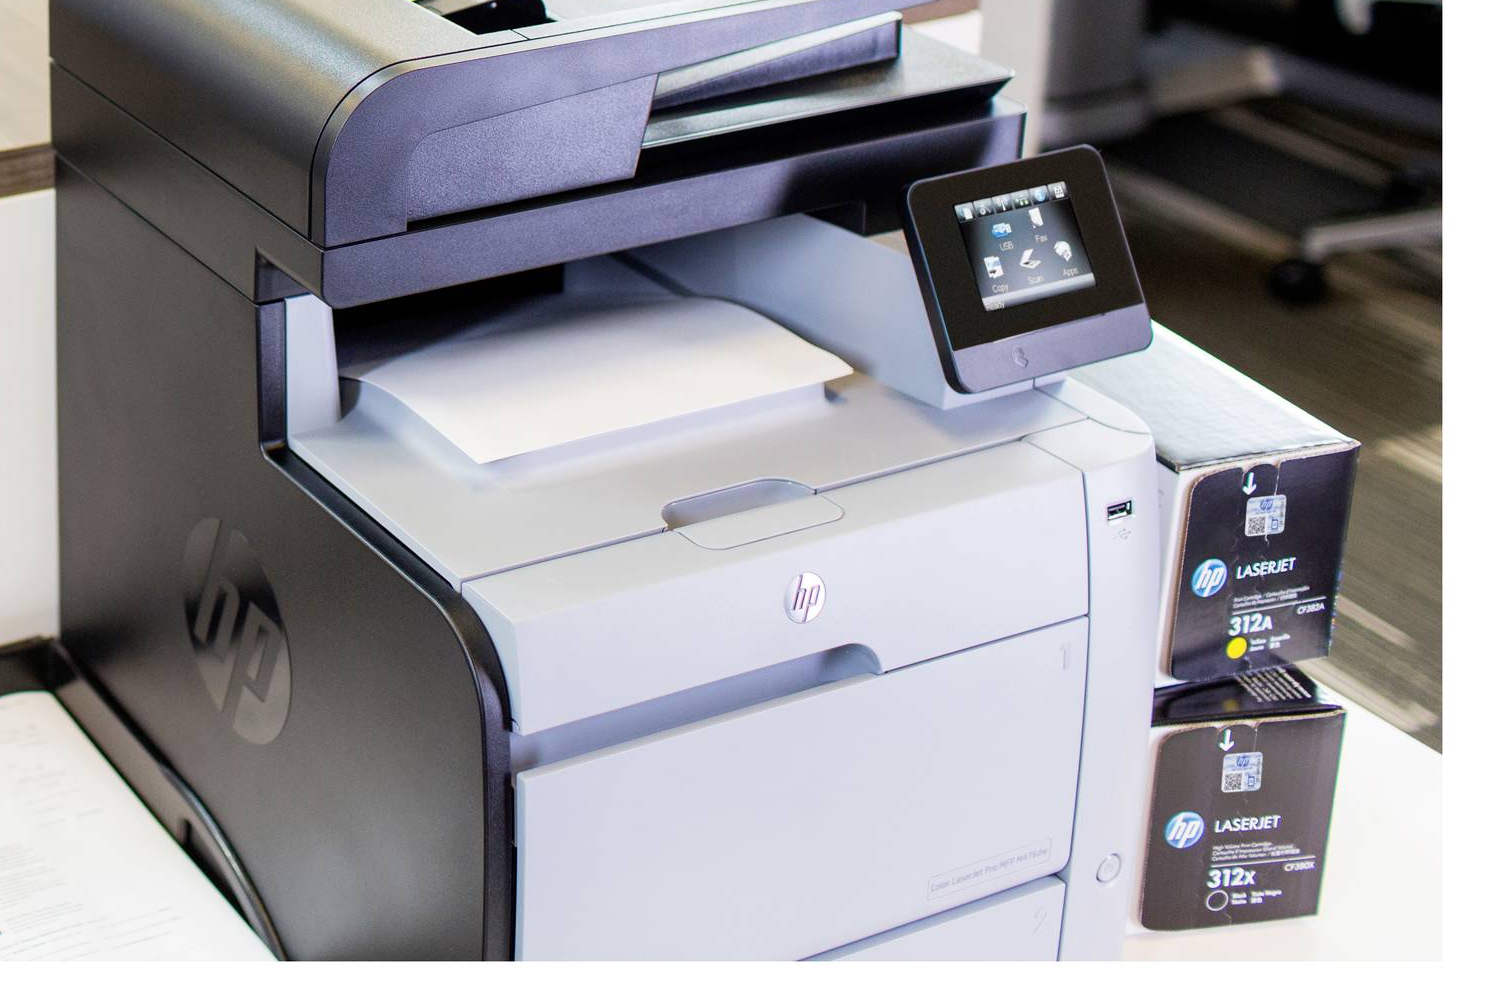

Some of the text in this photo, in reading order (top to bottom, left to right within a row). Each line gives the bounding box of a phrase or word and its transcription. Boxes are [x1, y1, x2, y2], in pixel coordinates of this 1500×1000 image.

[1035, 234, 1048, 243] Fax
[1000, 240, 1014, 251] USB
[1062, 267, 1079, 277] Apps
[1028, 275, 1045, 285] Scan
[992, 284, 1009, 294] Copy
[1195, 558, 1225, 598] hp
[1235, 557, 1297, 579] LASERJET
[790, 572, 822, 623] hp
[1228, 612, 1273, 636] 312A
[1166, 812, 1281, 849] hp LASERJET
[984, 864, 998, 874] Pro
